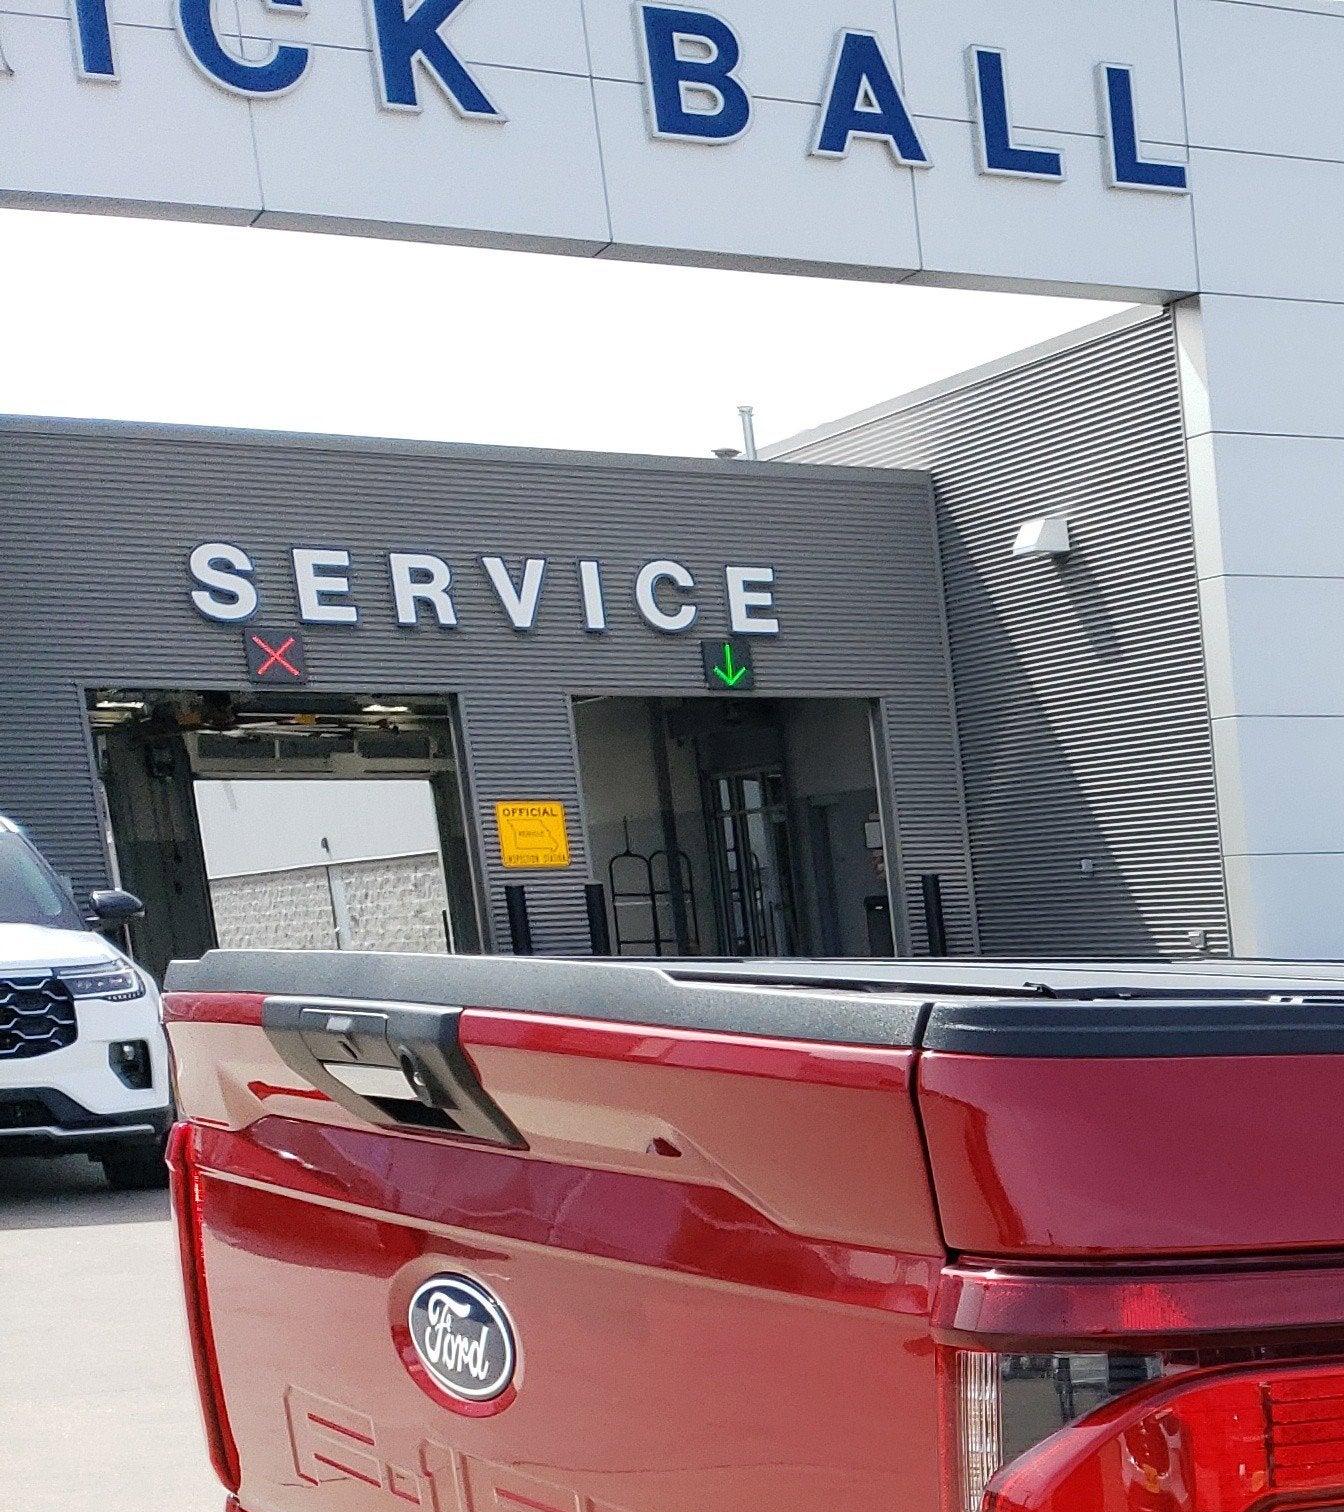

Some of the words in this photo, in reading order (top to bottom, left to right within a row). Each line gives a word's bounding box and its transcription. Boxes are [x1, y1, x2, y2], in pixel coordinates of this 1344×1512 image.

[0, 0, 508, 125] ICK
[635, 0, 1190, 196] BALL
[187, 541, 781, 636] SERVICE
[502, 807, 558, 818] OFFICIAL
[424, 1291, 490, 1380] Ford
